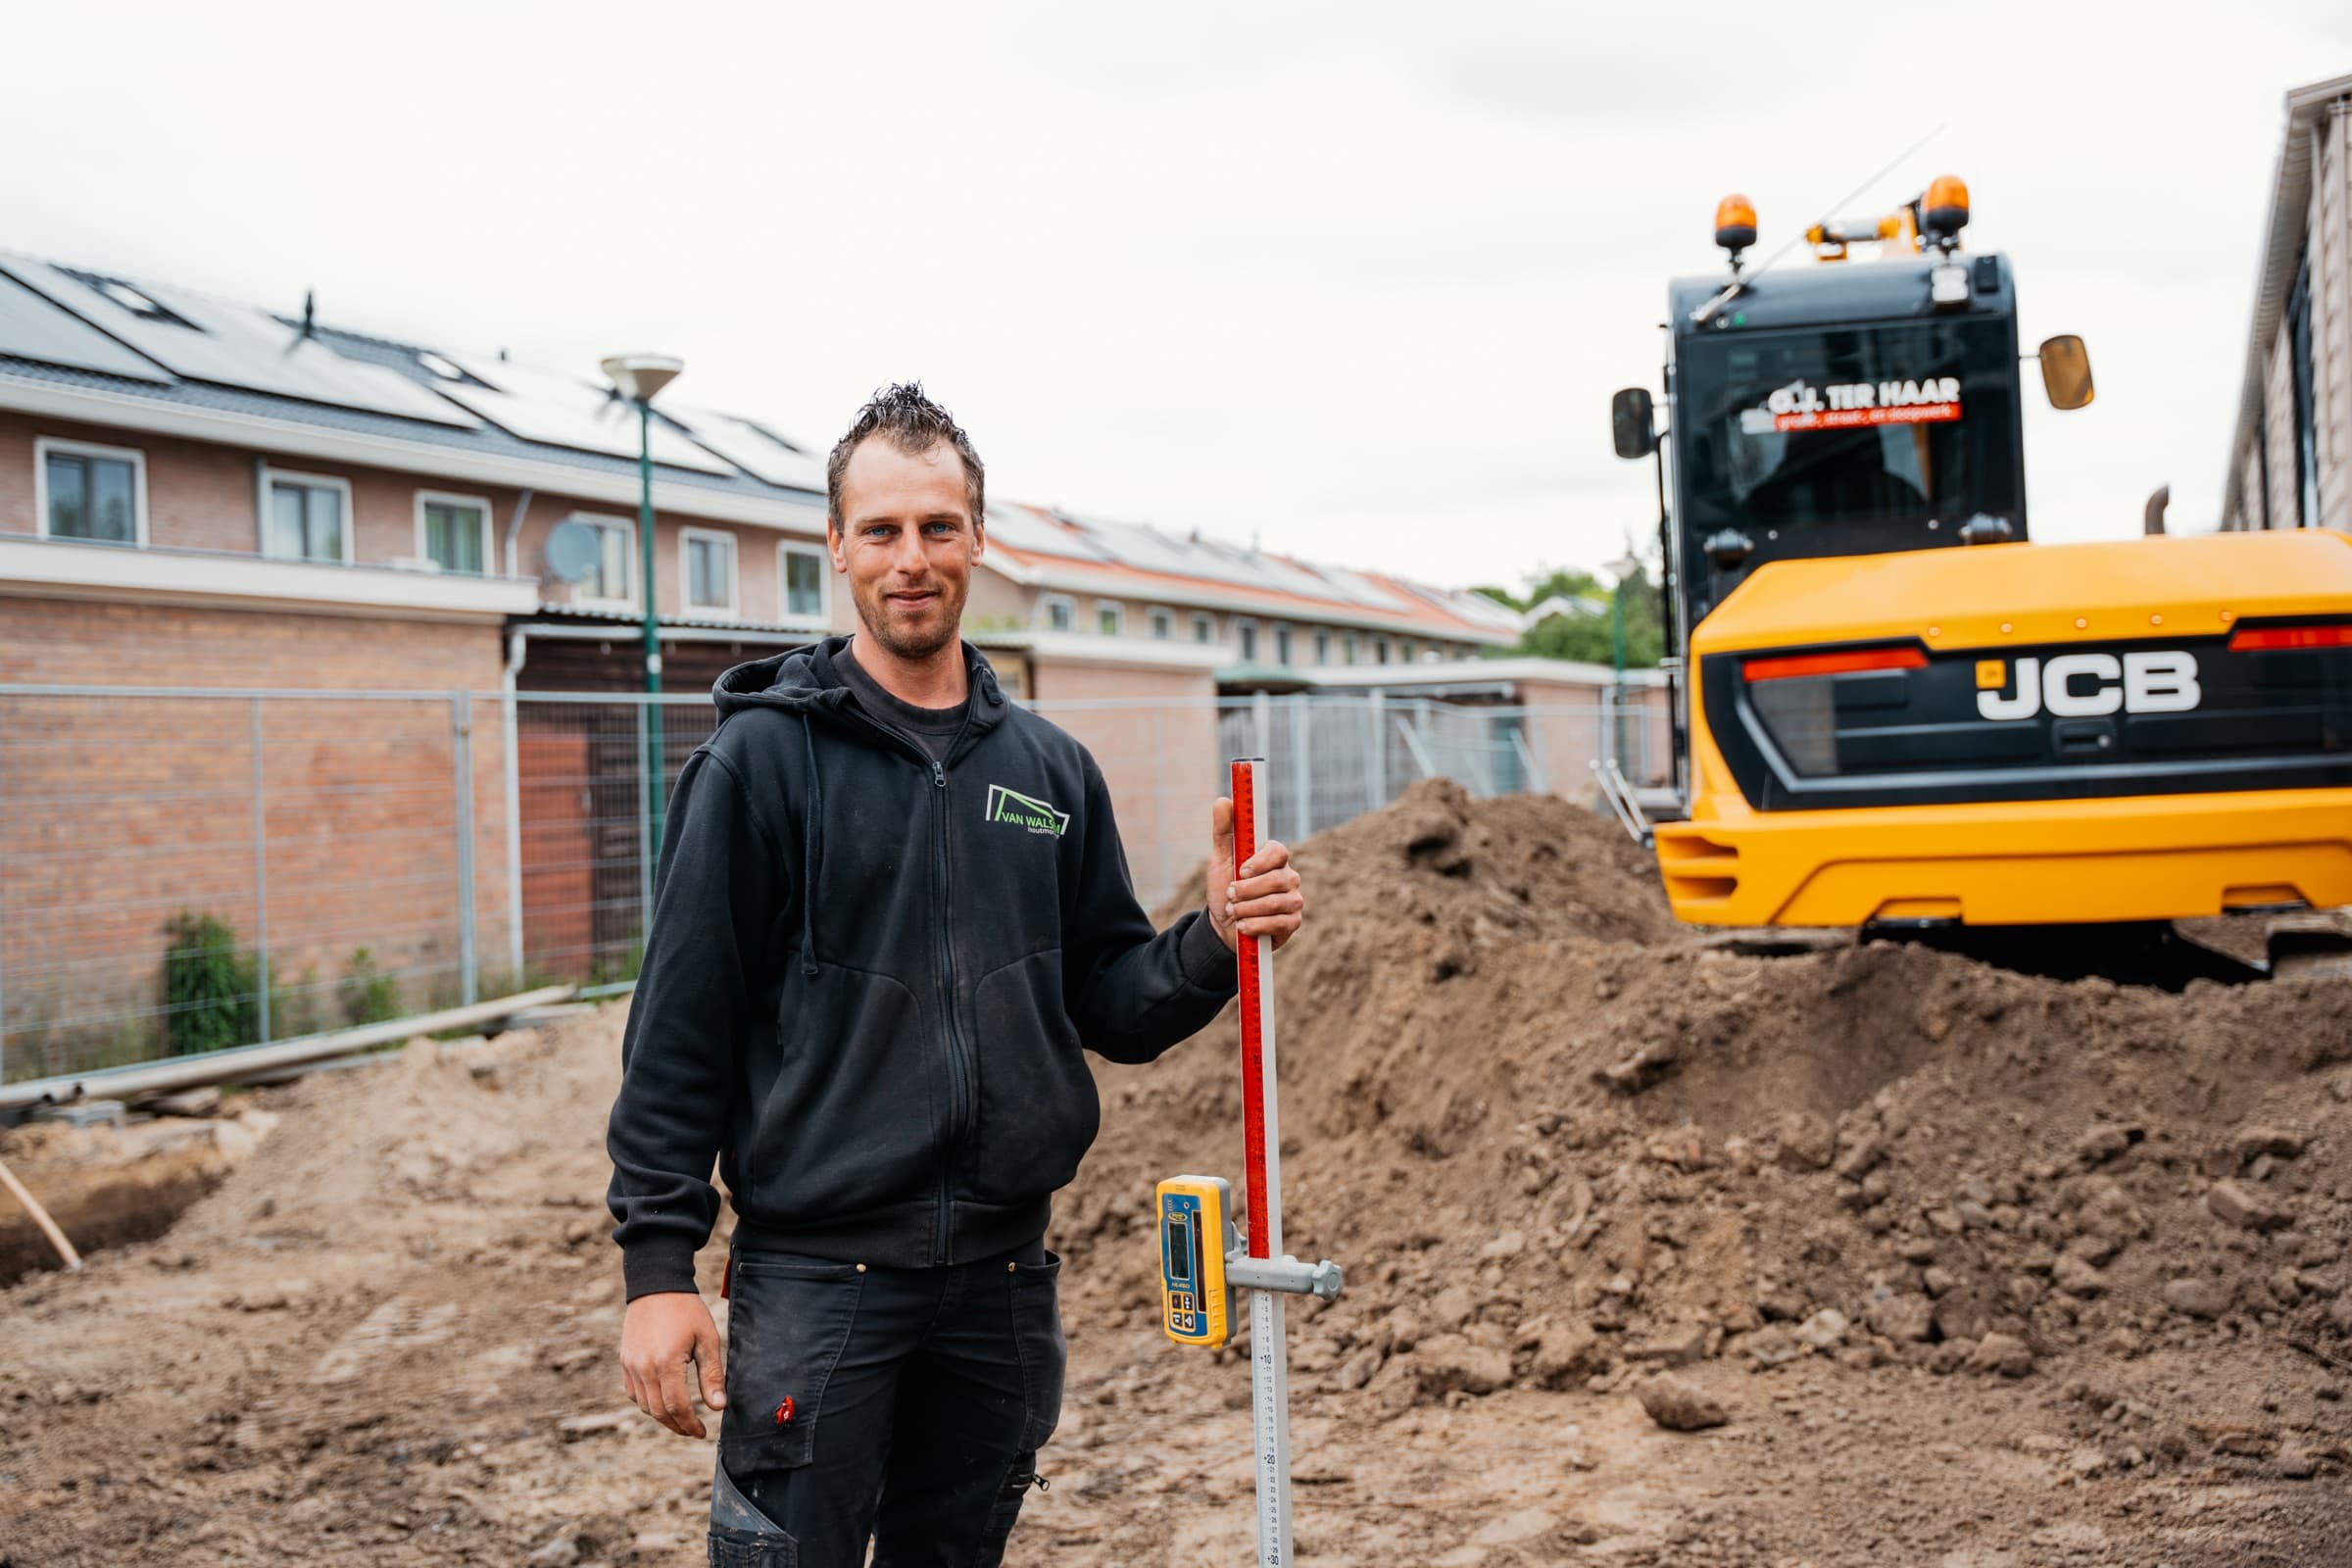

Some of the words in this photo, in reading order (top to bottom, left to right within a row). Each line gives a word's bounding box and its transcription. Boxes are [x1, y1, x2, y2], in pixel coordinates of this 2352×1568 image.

[1826, 383, 1876, 410] TER
[1879, 377, 1960, 406] HAAR
[1975, 650, 2202, 721] JCB
[1002, 811, 1023, 825] VAN
